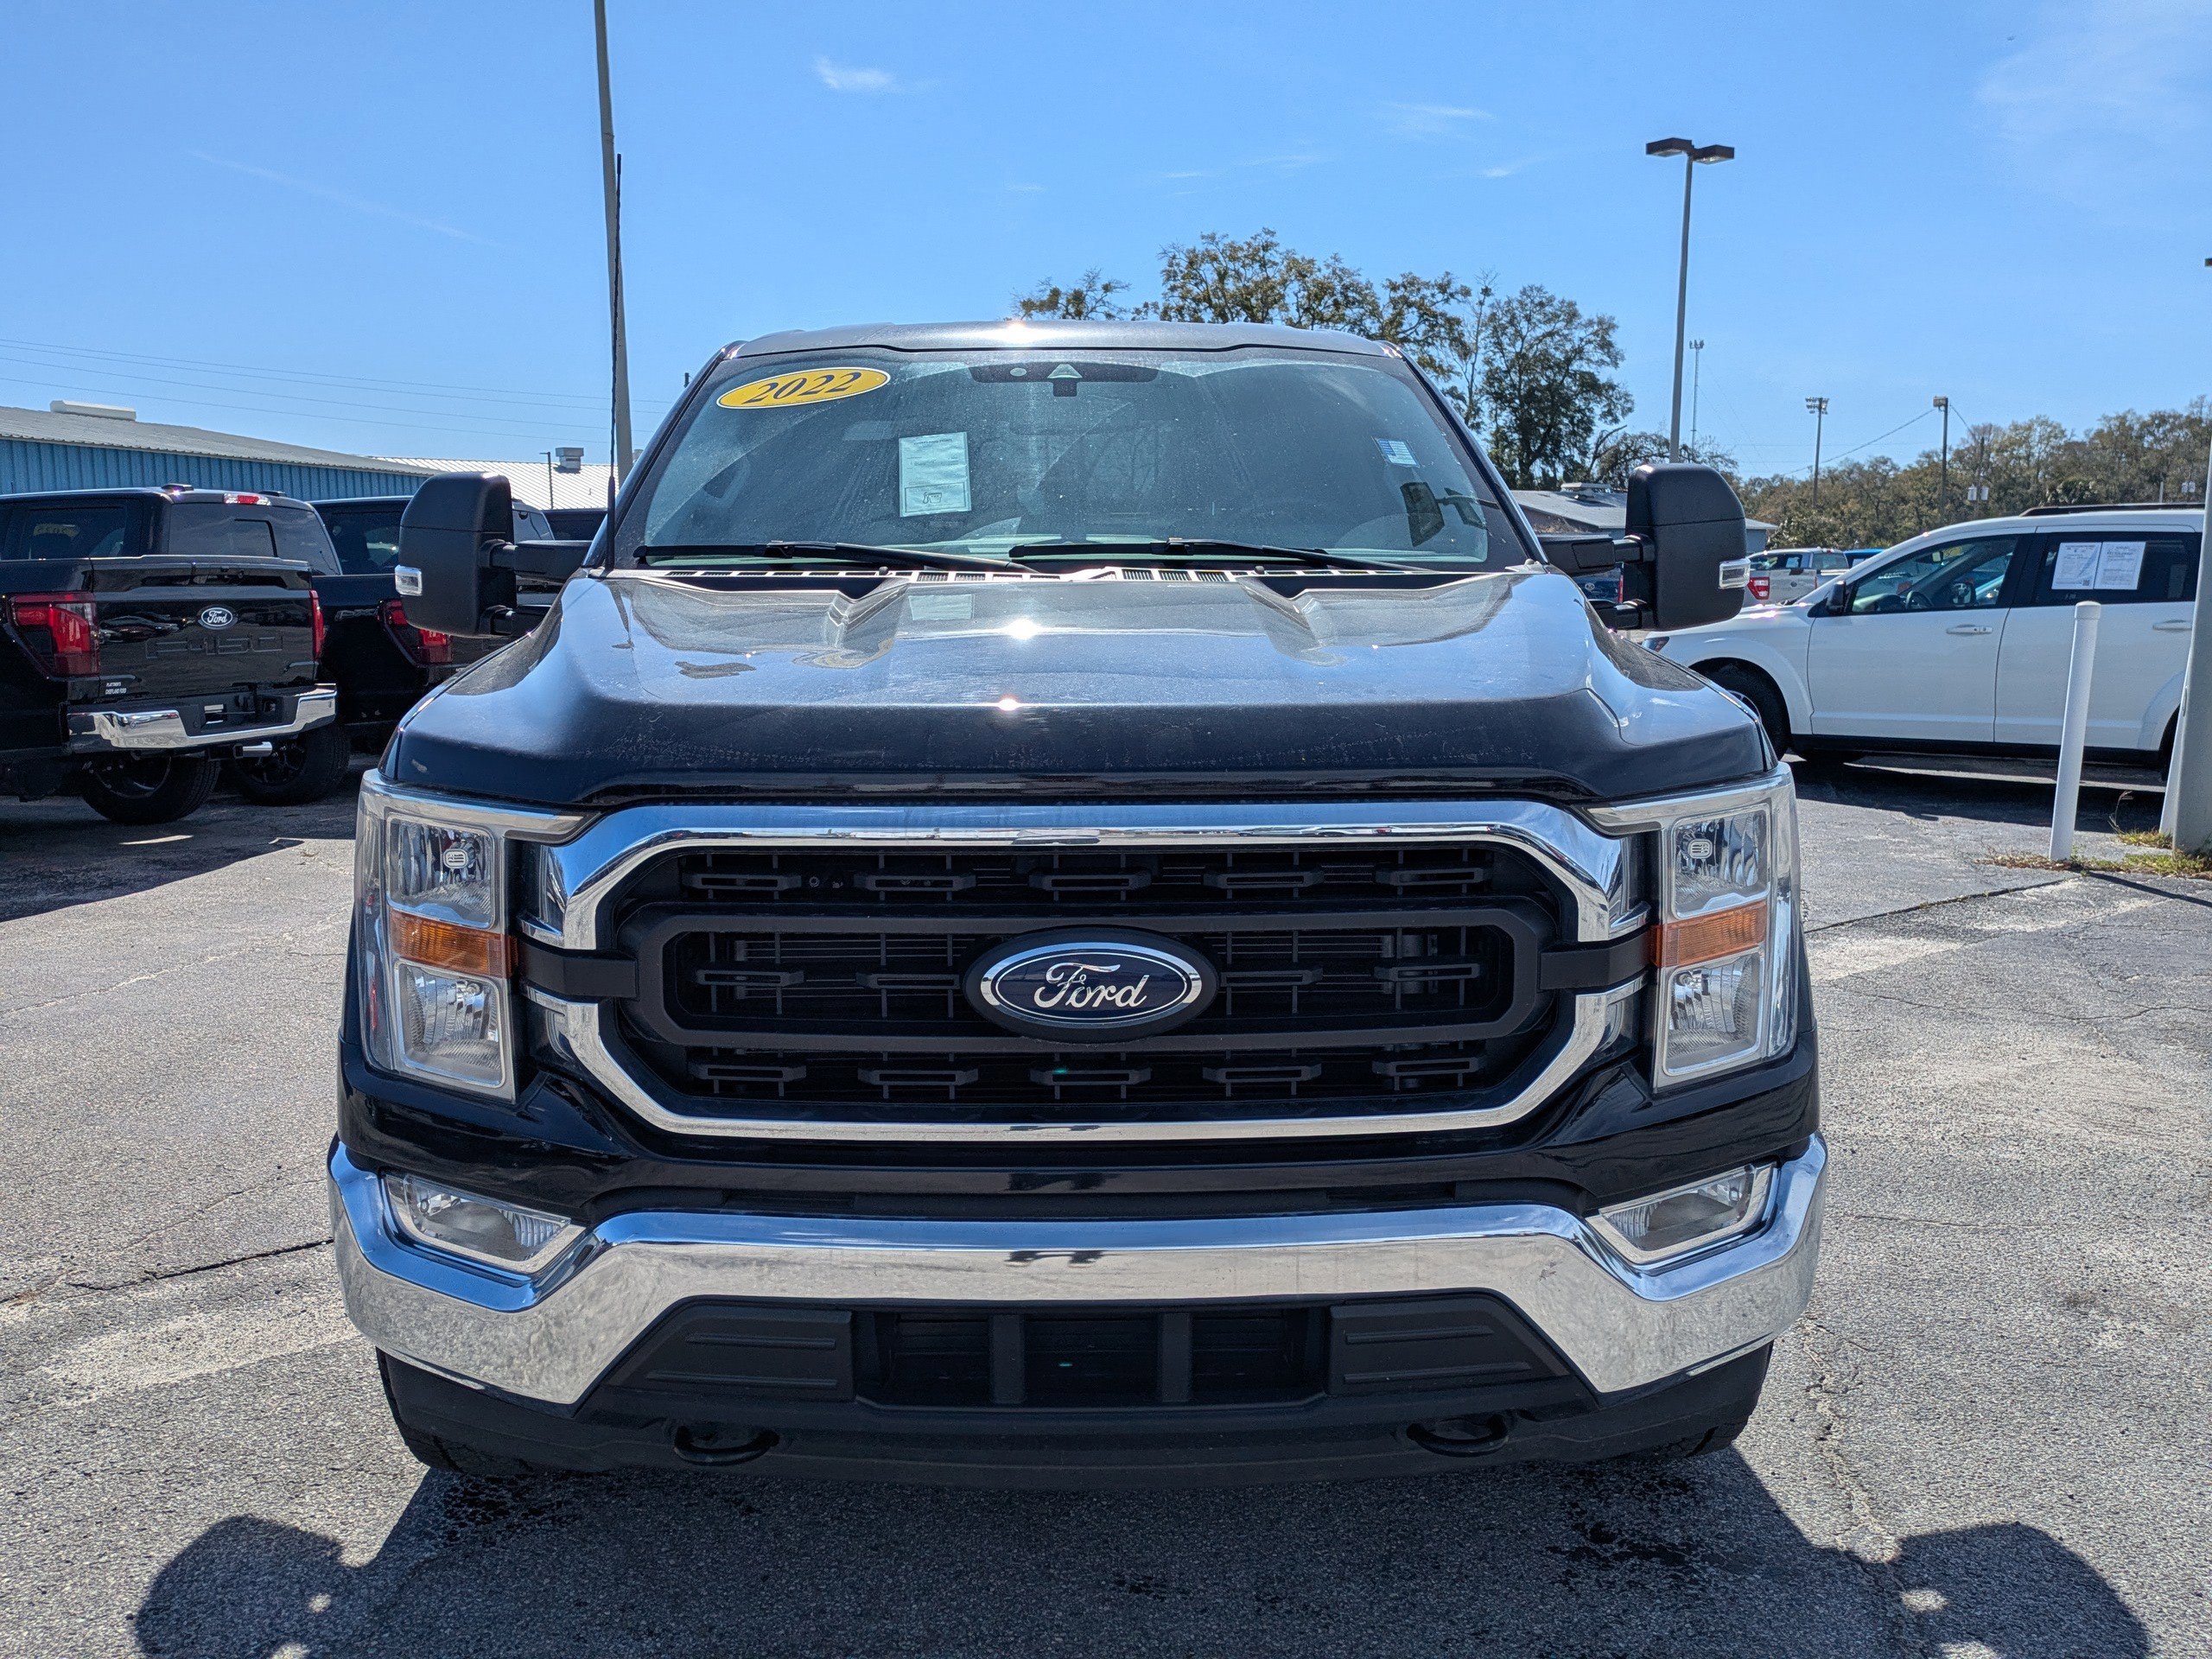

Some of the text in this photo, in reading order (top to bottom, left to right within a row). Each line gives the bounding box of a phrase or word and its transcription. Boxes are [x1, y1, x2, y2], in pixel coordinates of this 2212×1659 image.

[741, 372, 862, 404] 2022
[207, 610, 227, 623] Ford
[1033, 962, 1150, 1008] Ford
